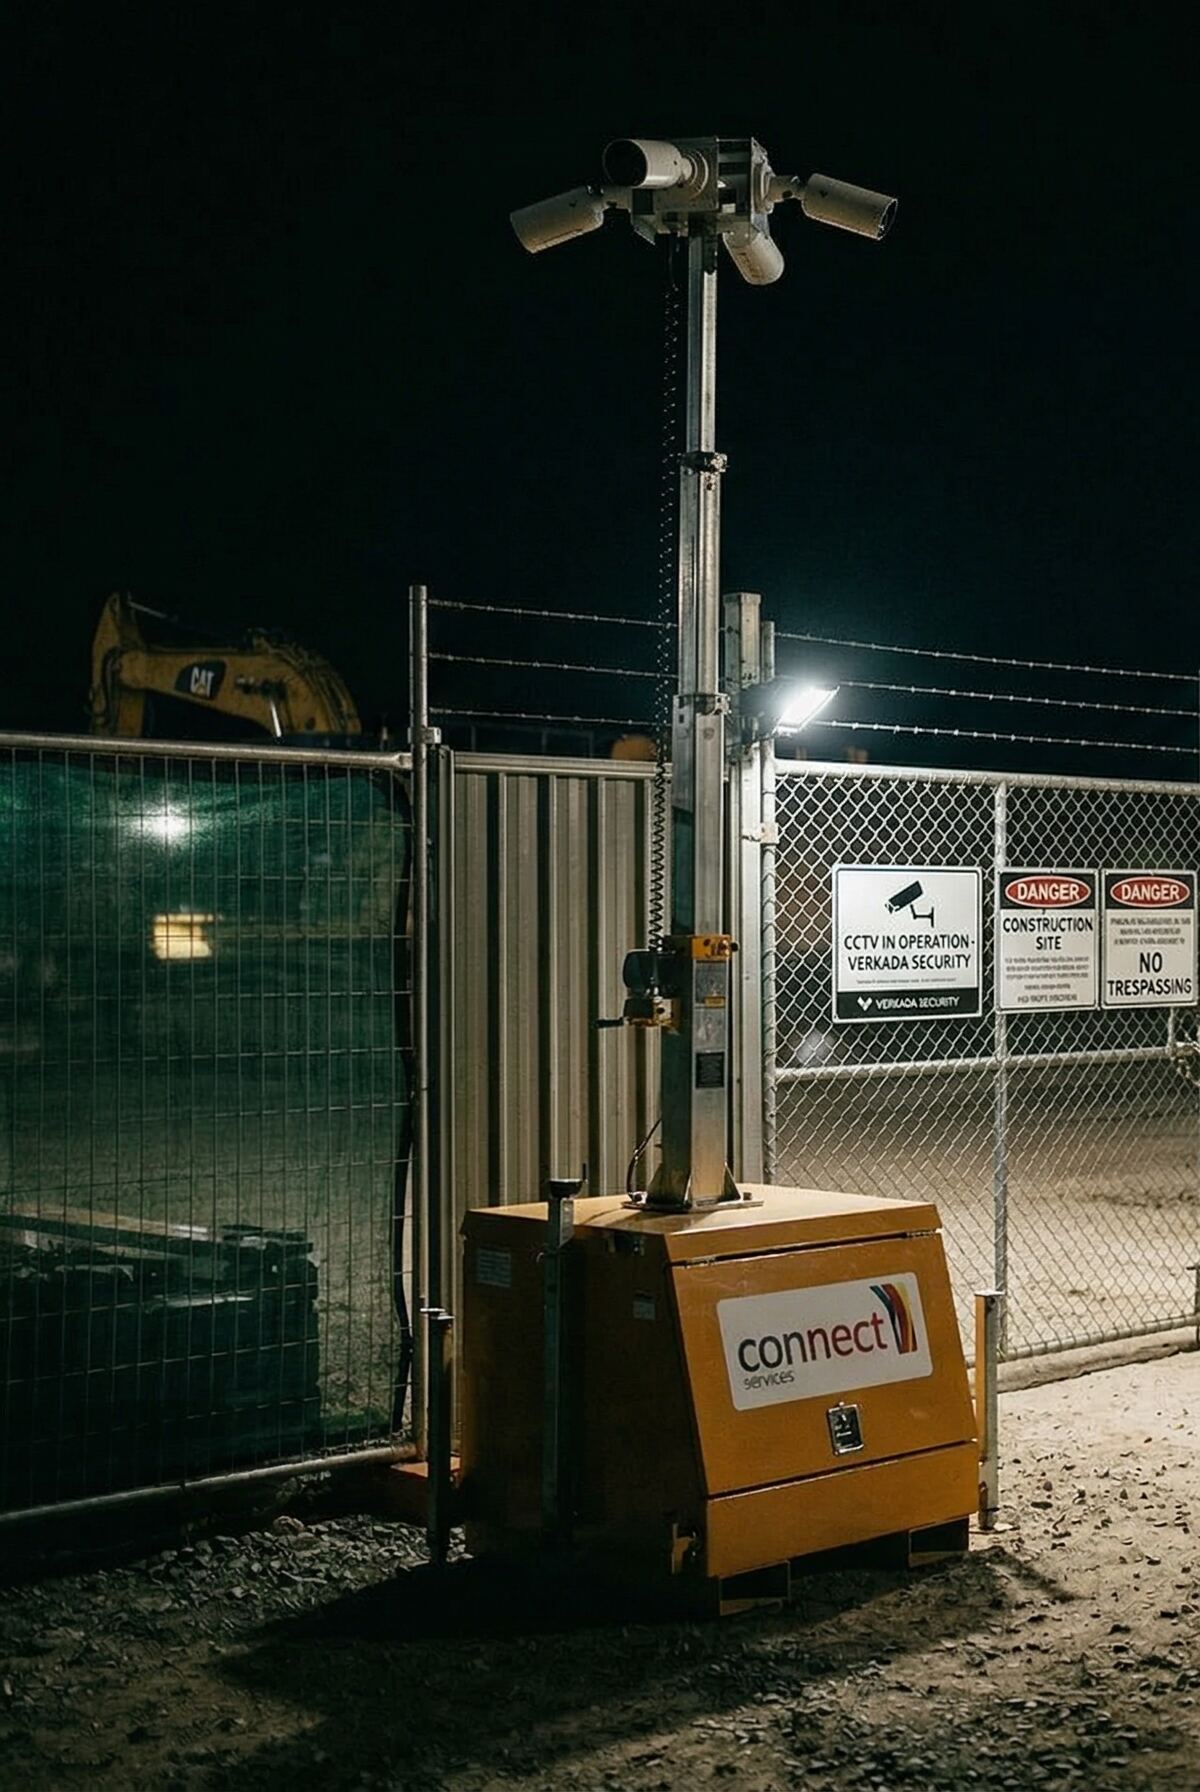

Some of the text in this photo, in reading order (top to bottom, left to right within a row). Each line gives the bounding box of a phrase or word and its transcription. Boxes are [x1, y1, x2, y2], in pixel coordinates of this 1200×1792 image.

[190, 666, 214, 697] CAT
[1017, 882, 1080, 901] DANGER
[1121, 883, 1180, 901] DANGER
[1003, 917, 1094, 933] CONSTRUCTION
[844, 934, 879, 950] CCTV
[882, 935, 896, 950] IN
[898, 934, 969, 950] OPERATION
[1036, 935, 1062, 951] SITE
[848, 953, 971, 971] VERKADA SECURITY
[1140, 951, 1163, 973] NO
[1107, 978, 1192, 996] TRESPASSING
[737, 1311, 888, 1373] connect
[743, 1369, 795, 1391] services
